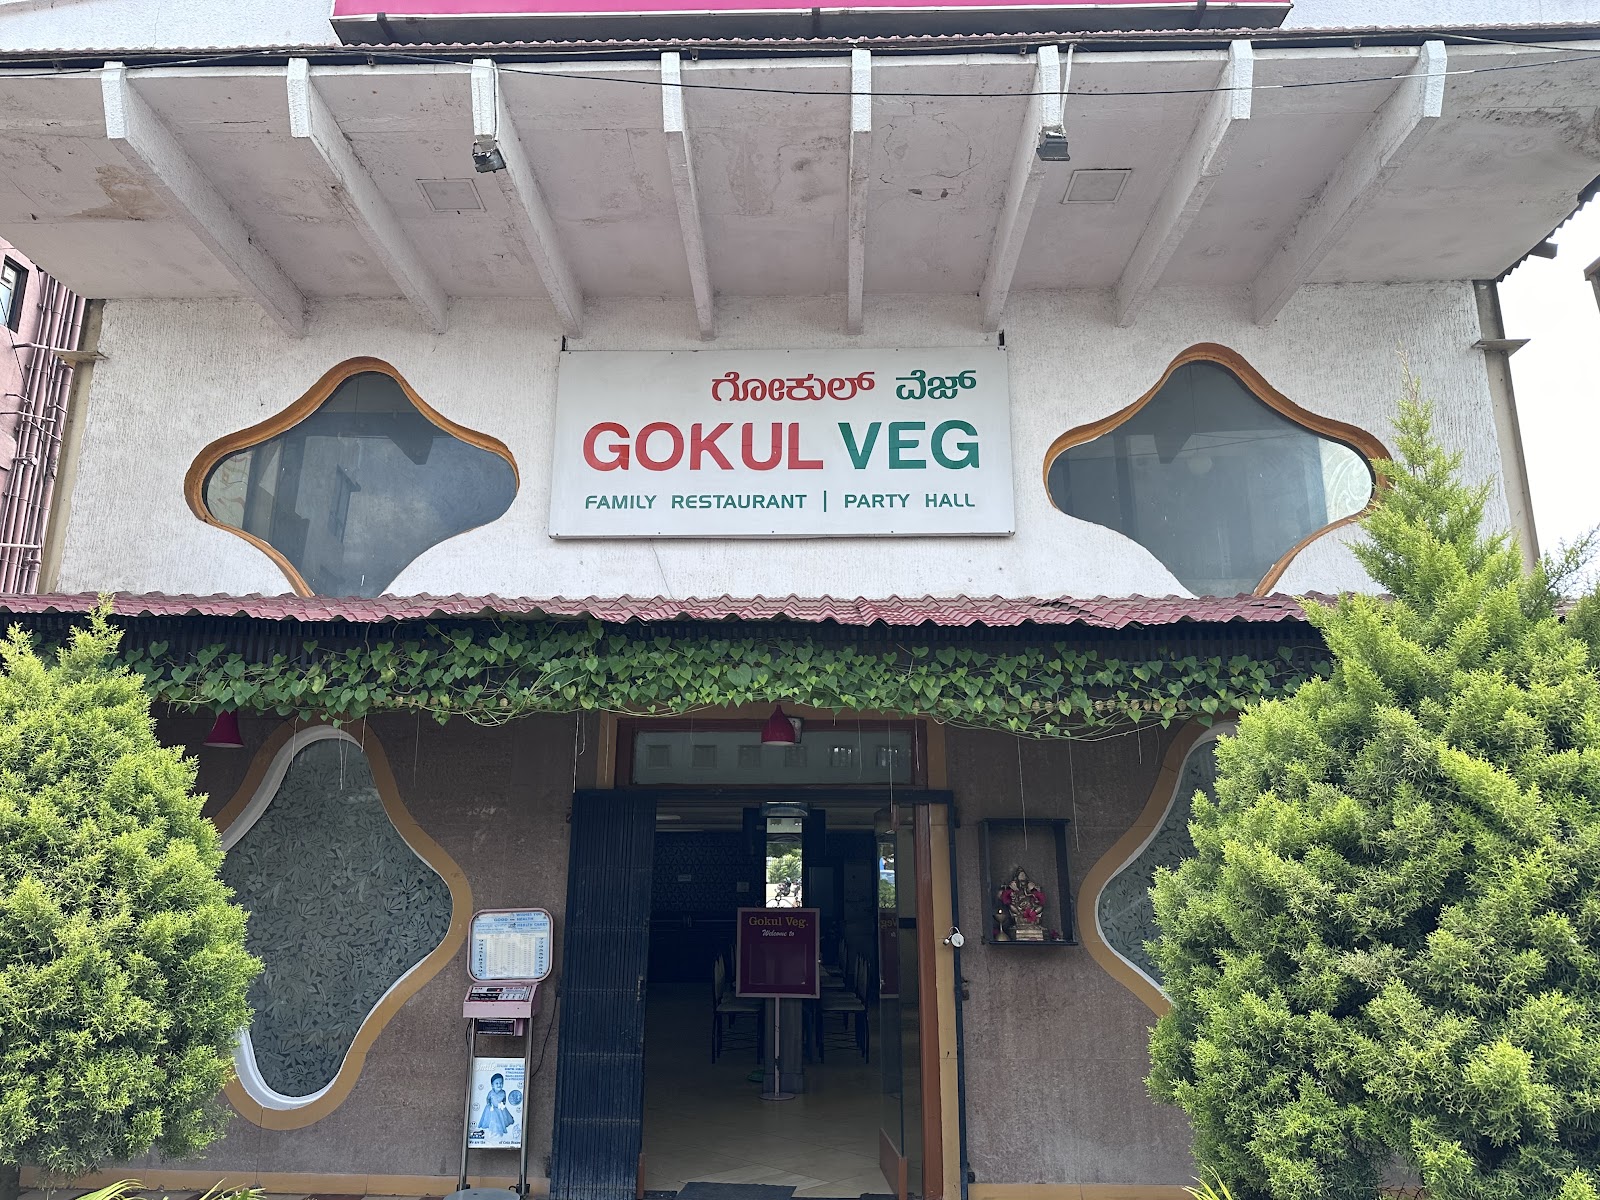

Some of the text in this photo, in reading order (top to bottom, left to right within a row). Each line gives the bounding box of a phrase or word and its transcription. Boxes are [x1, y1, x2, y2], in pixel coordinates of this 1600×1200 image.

[711, 369, 977, 402] ಗೋಕುಲ್ ವೆಜ್
[583, 419, 980, 472] GOKUL VEG
[585, 494, 657, 509] FAMILY
[671, 494, 807, 509] RESTAURANT
[844, 493, 910, 508] PARTY
[925, 493, 976, 508] HALL
[749, 916, 809, 928] Gokul Veg.
[762, 929, 787, 937] Welcome
